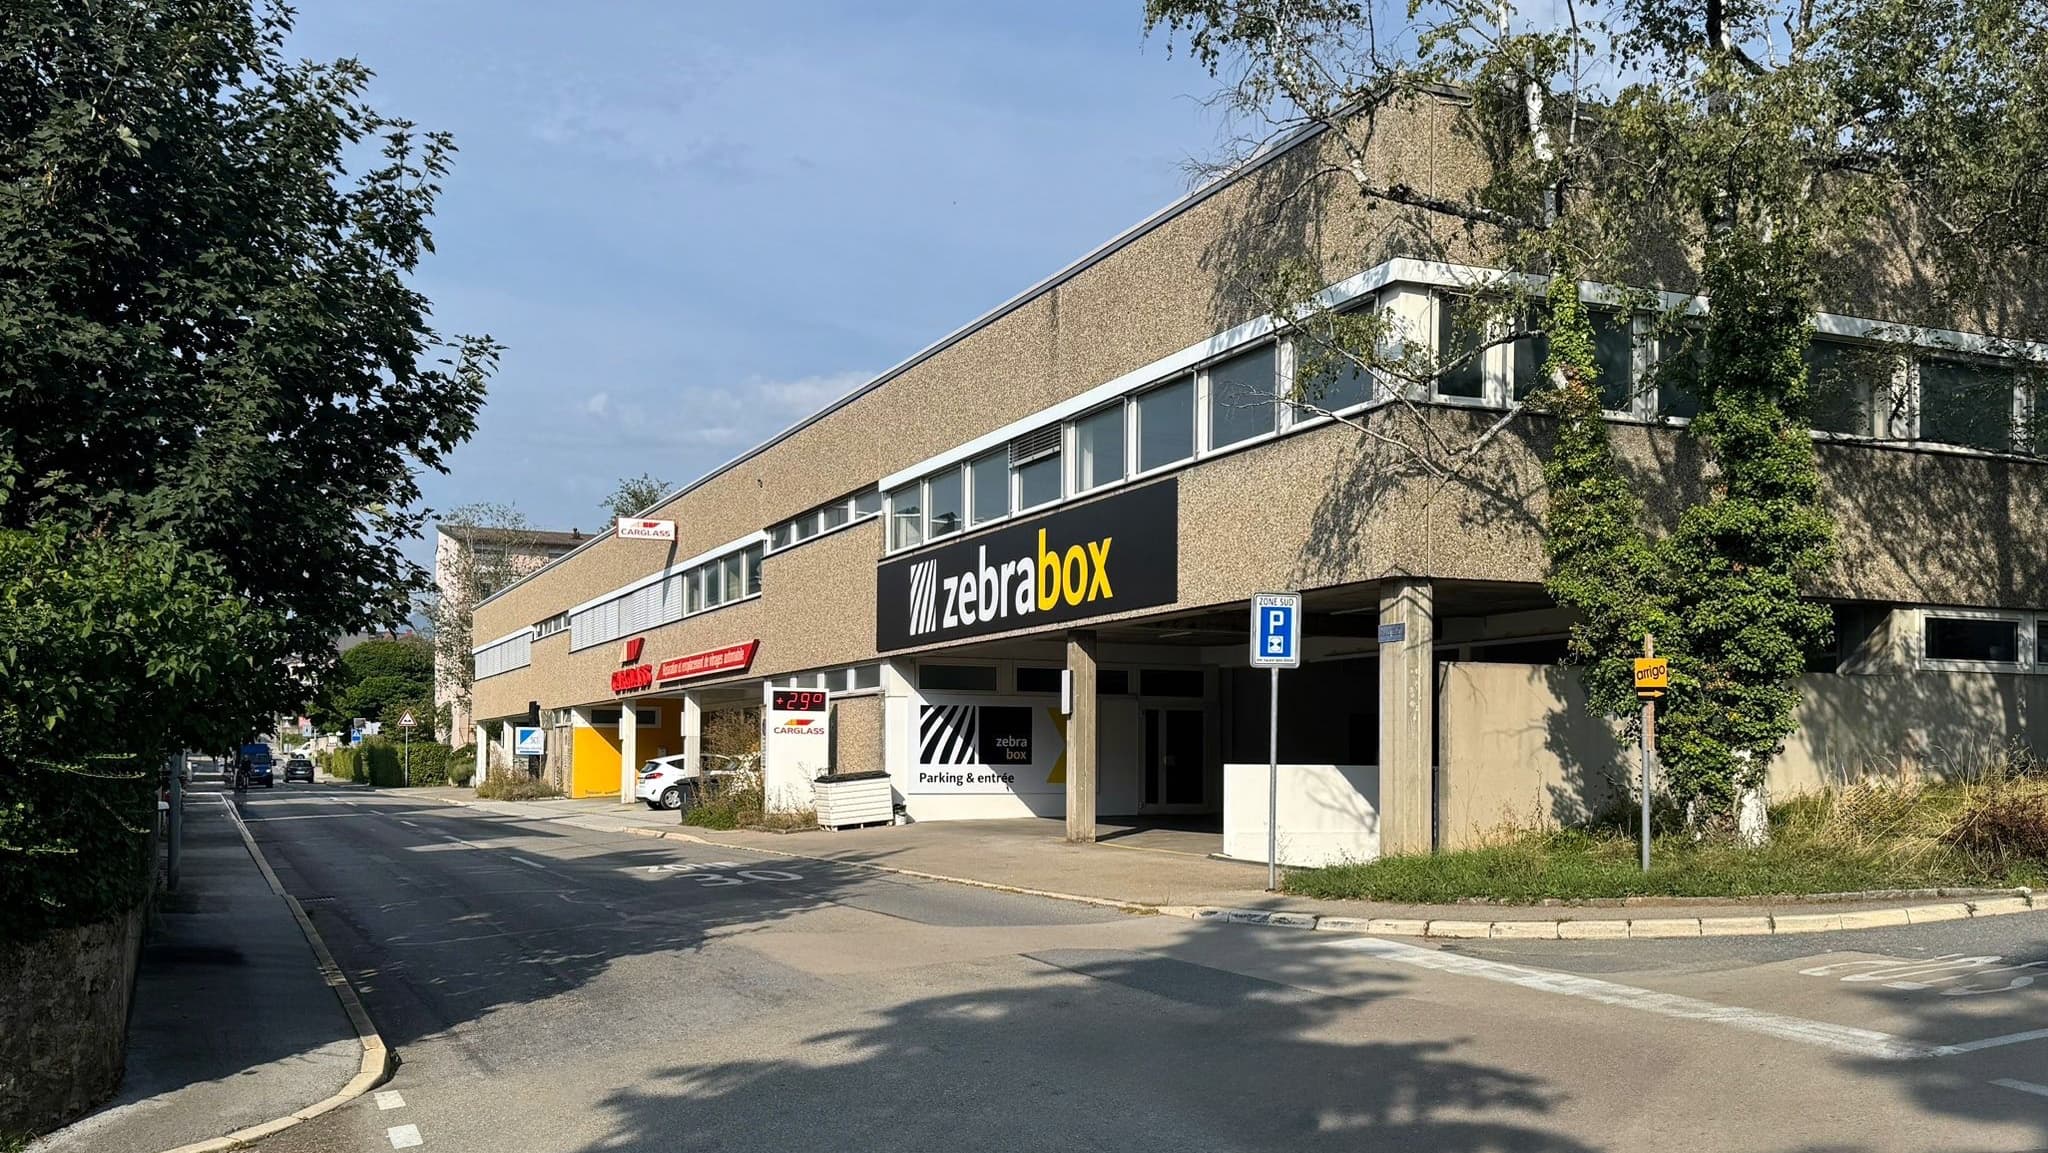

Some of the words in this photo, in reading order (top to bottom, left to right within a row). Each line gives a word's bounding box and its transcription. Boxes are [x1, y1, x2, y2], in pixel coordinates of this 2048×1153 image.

[620, 528, 671, 537] CARGLASS
[943, 528, 1113, 629] zebrabox
[1258, 597, 1278, 606] ZONE
[1279, 598, 1294, 606] SUD
[1269, 610, 1284, 634] P
[1636, 664, 1666, 680] arrigo
[773, 726, 825, 735] CARGLASS
[995, 735, 1028, 747] zebra
[1006, 747, 1027, 760] box
[919, 771, 964, 787] Parking
[966, 772, 975, 783] &
[977, 771, 1016, 783] entrée
[674, 869, 804, 887] 30
